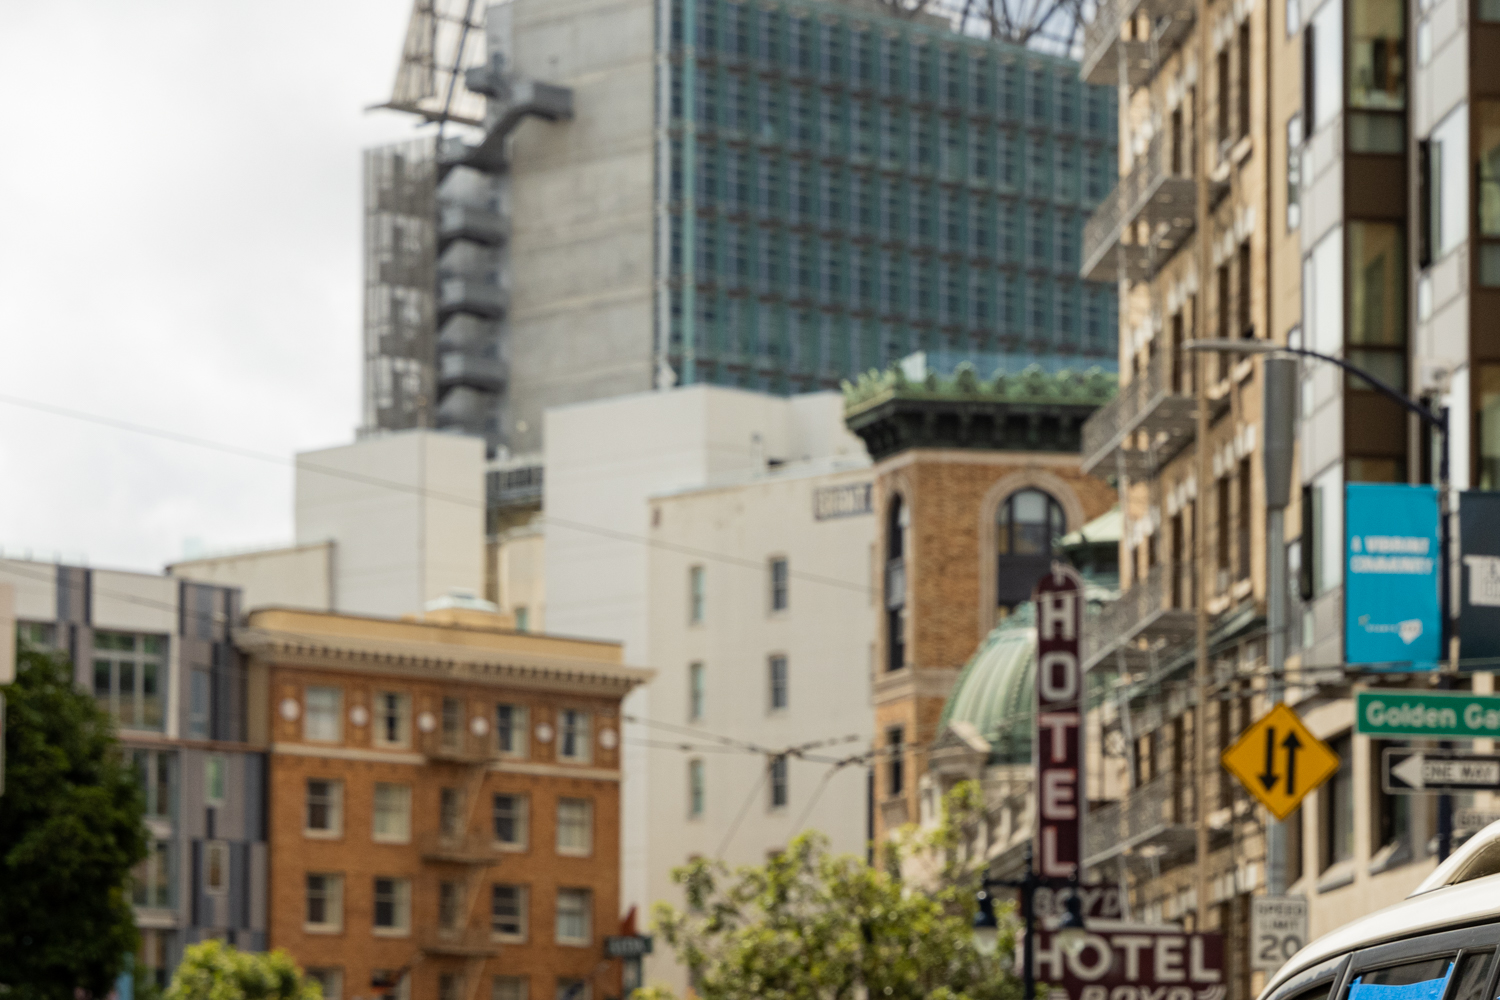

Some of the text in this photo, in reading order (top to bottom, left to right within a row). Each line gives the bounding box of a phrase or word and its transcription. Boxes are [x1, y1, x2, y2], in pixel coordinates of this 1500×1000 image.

[1365, 700, 1458, 728] Golden
[1039, 591, 1079, 877] HOTEL
[1424, 764, 1493, 780] ONE WAY
[1258, 904, 1303, 916] SPEED
[1032, 933, 1222, 982] HOTEL
[1259, 933, 1302, 961] 20
